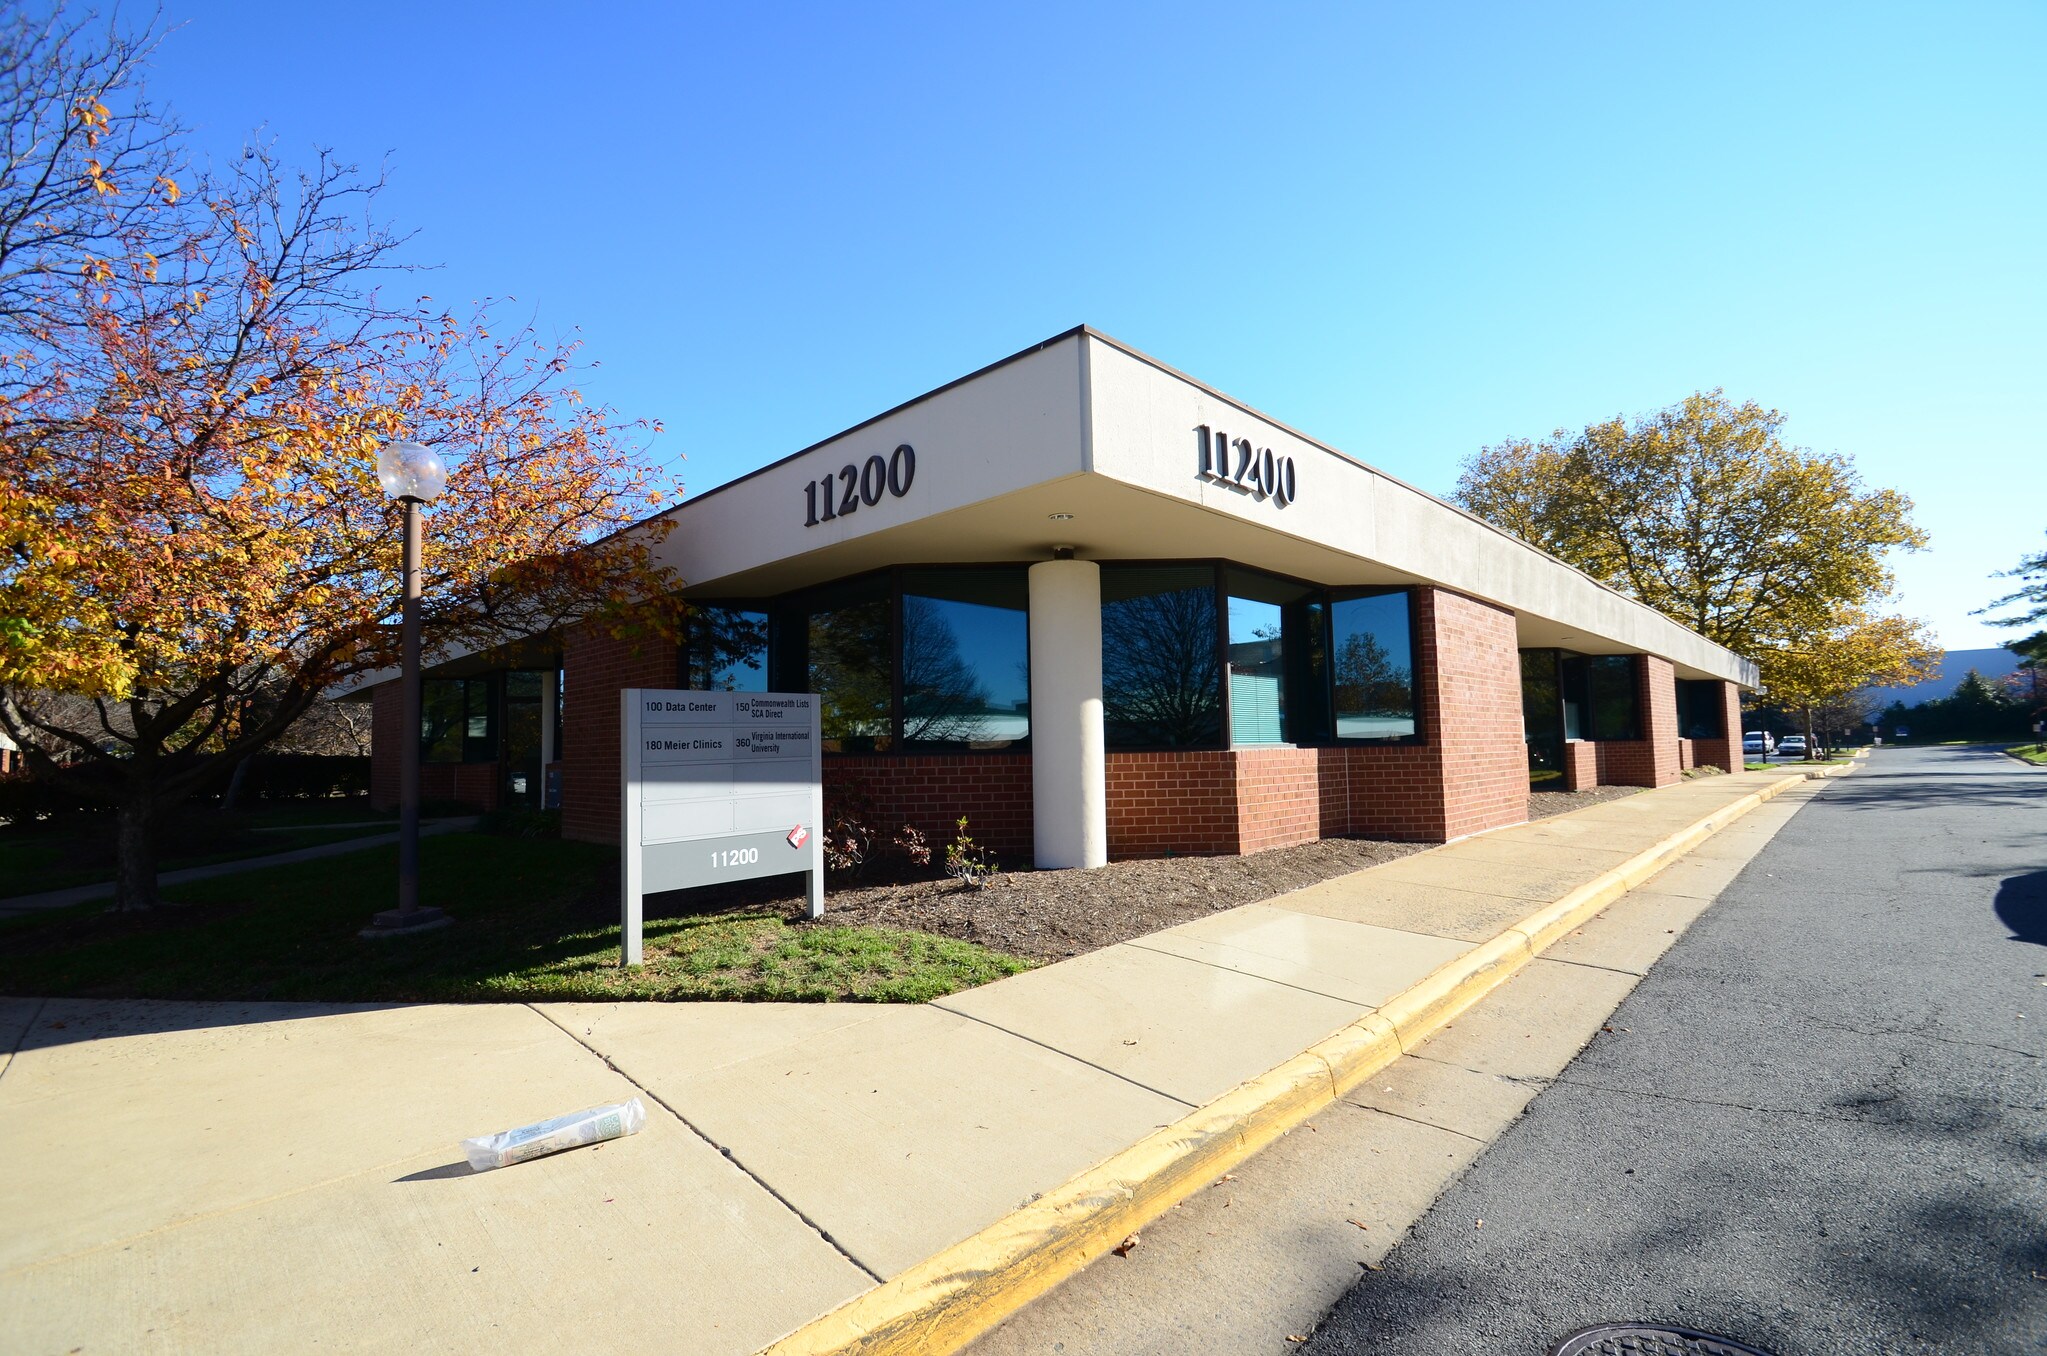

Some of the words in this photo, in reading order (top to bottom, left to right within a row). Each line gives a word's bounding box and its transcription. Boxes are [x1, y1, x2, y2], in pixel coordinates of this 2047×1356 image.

[1196, 422, 1297, 506] 11200
[804, 443, 916, 527] 11200
[646, 702, 662, 712] 100
[666, 702, 686, 712] Data
[688, 702, 717, 712] Center
[735, 702, 750, 712] 150
[751, 698, 795, 708] Commonwealth
[797, 699, 809, 708] Lists
[751, 709, 764, 718] SCA
[765, 709, 783, 718] Direct
[751, 731, 774, 742] Virginia
[775, 731, 810, 740] International
[646, 740, 662, 751] 180
[664, 740, 690, 750] Meier
[692, 739, 723, 750] Clinics
[735, 738, 750, 748] 360
[751, 743, 780, 754] University
[711, 847, 759, 869] 11200
